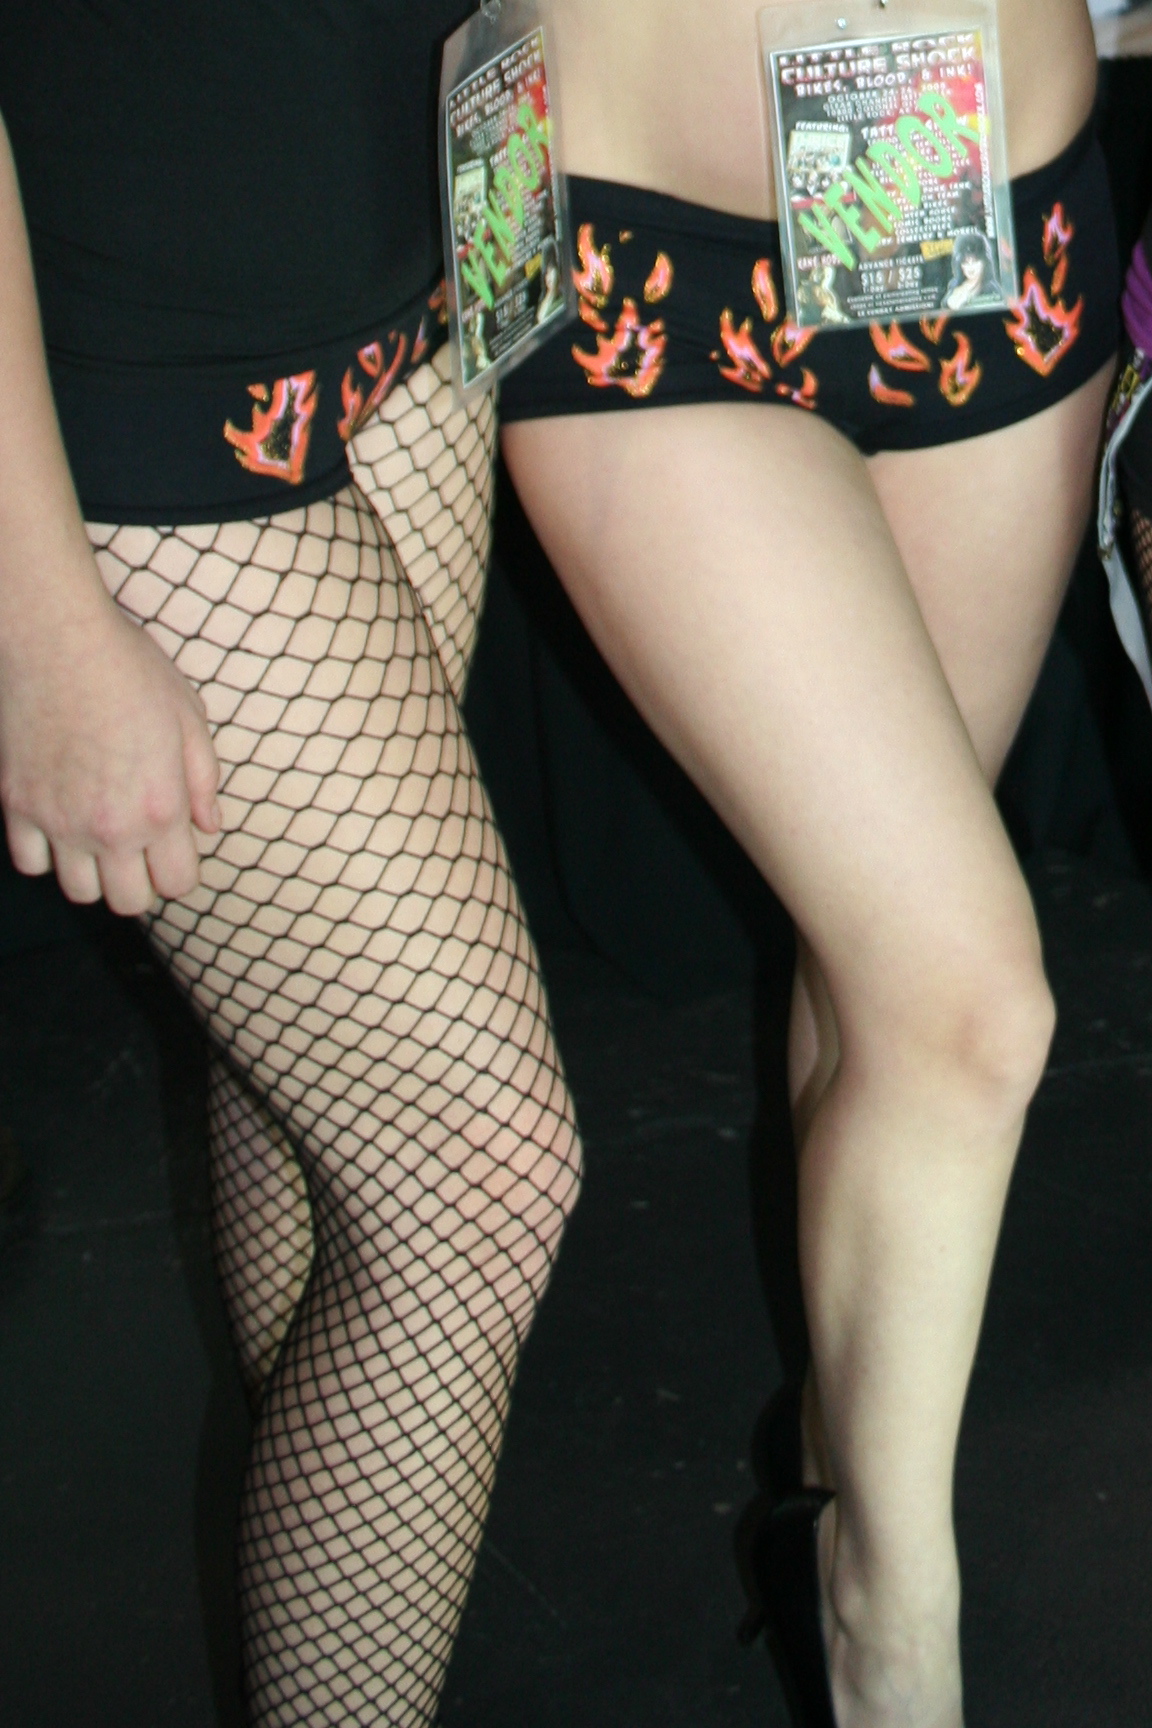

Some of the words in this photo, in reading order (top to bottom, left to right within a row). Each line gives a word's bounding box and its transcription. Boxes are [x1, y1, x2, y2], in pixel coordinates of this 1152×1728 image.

[781, 57, 888, 85] CULTURE
[896, 47, 975, 69] SHOCK
[461, 103, 551, 309] VENDOR
[798, 90, 981, 270] VENDOR
